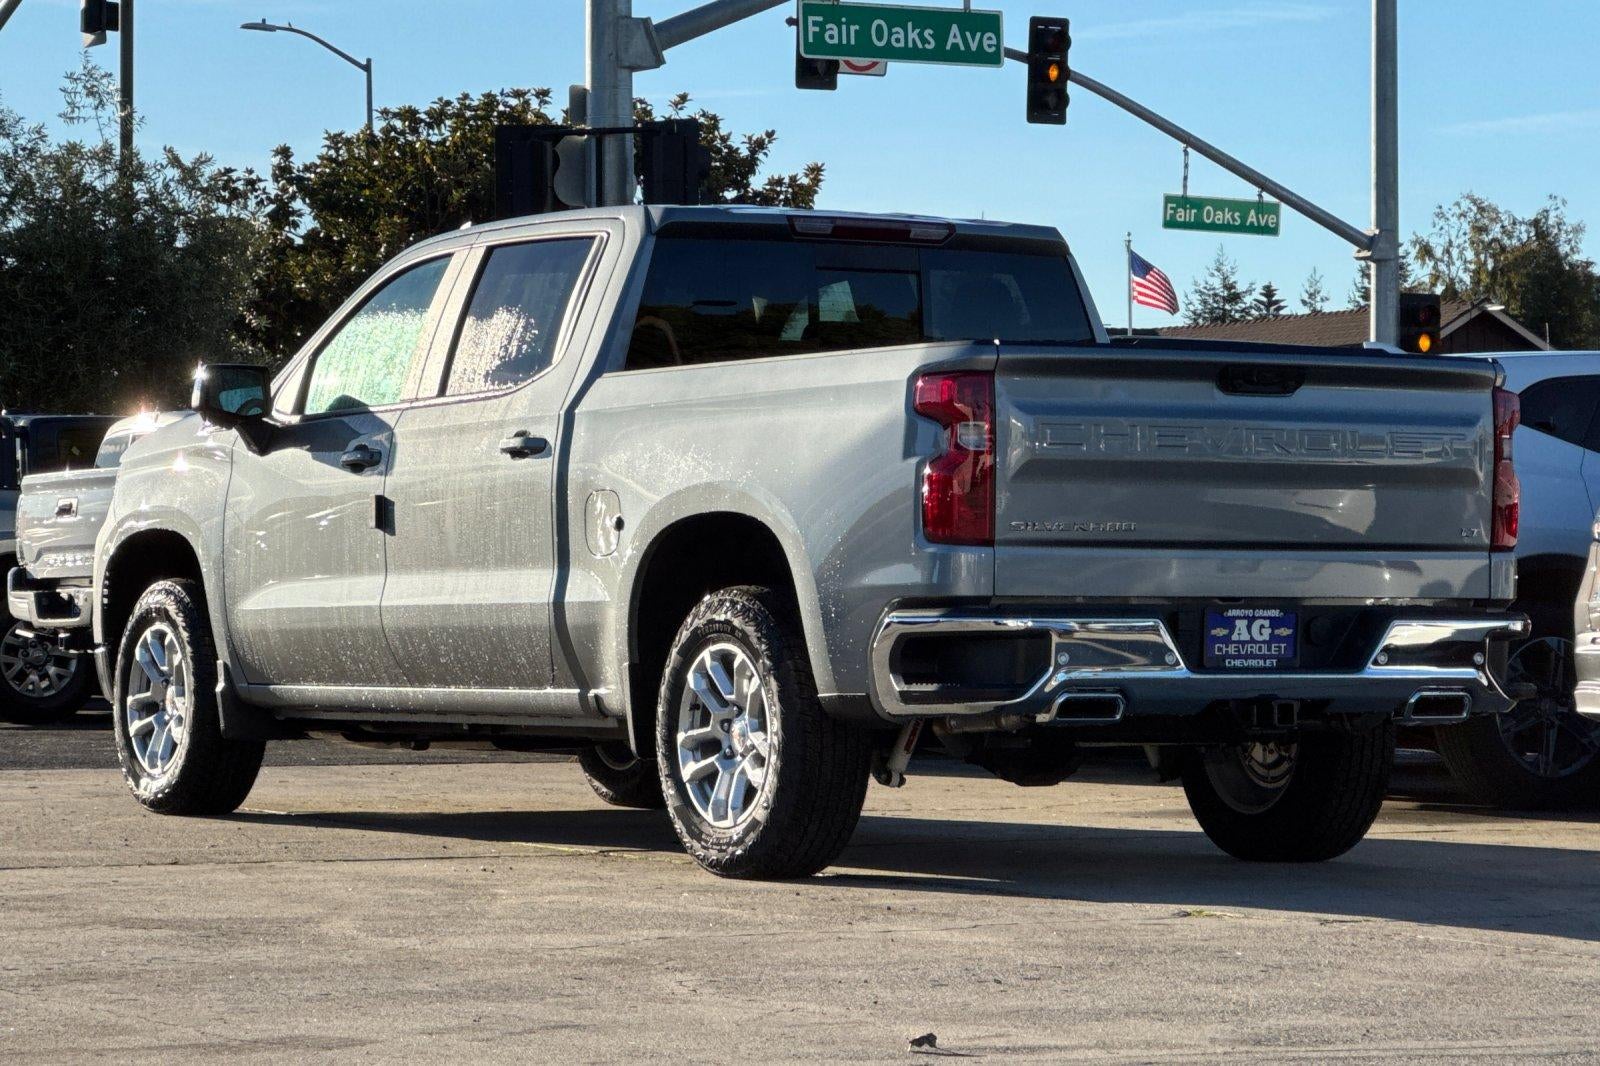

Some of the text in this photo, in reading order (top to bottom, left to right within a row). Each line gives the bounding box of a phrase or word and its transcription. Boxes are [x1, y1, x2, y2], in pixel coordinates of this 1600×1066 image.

[807, 15, 997, 52] Fair Oaks Ave
[1166, 203, 1277, 227] Fair Oaks Ave
[1039, 422, 1466, 457] CHEVROLET
[1227, 609, 1280, 617] ARROYO GRANDE
[1231, 619, 1272, 641] AG
[1215, 643, 1287, 655] CHEVROLET
[1225, 659, 1278, 667] CHEVROLET
